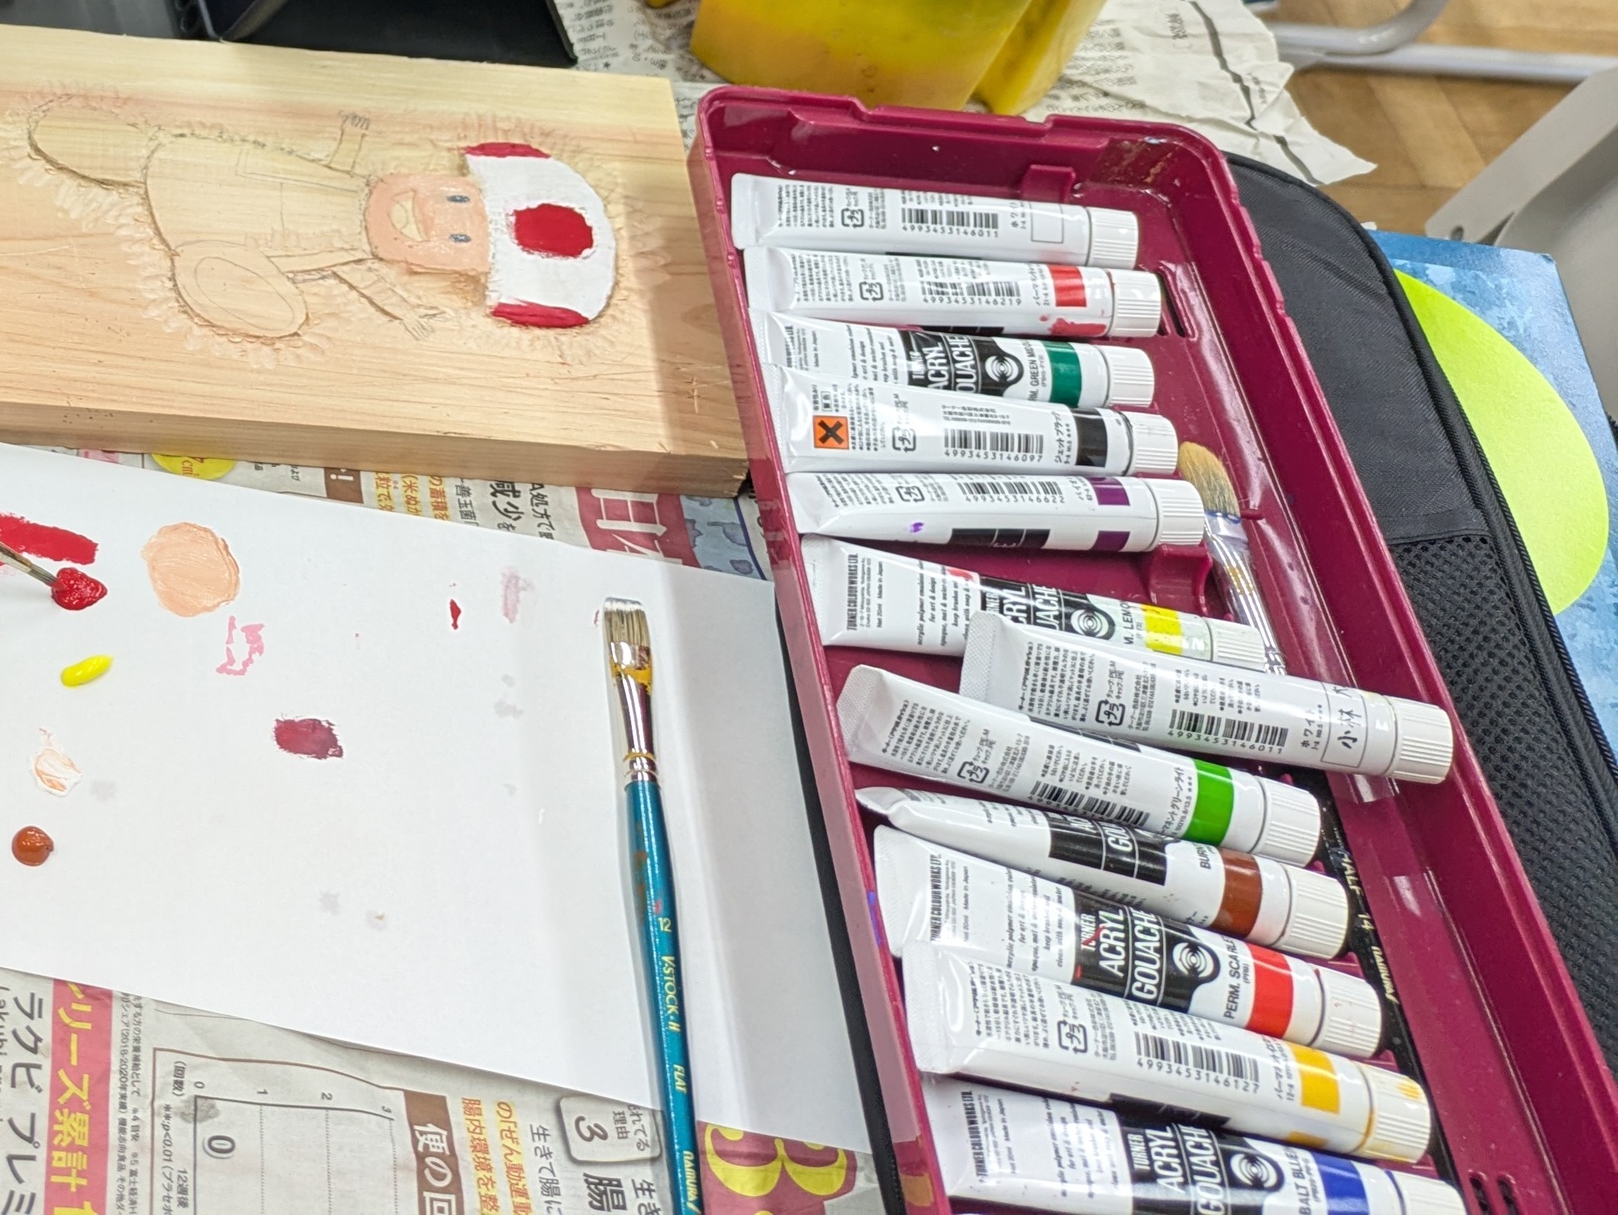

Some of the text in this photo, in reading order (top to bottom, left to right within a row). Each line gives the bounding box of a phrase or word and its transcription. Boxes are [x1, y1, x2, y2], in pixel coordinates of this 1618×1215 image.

[946, 334, 978, 394] OUACHE
[1028, 361, 1040, 388] GREEN
[944, 450, 1043, 463] 4993453146097
[848, 564, 858, 585] WORKS
[847, 586, 858, 607] COLOUR
[1003, 586, 1028, 624] CRYL
[1032, 584, 1060, 631] UACHE
[847, 607, 858, 631] TURNER
[1120, 601, 1134, 630] LEMO
[1167, 730, 1283, 755] 4993453146011
[1194, 842, 1212, 870] BURN
[930, 866, 942, 889] WORKS
[930, 890, 942, 916] COLOUR
[657, 917, 672, 933] 12
[1006, 915, 1015, 942] polymer
[1357, 912, 1375, 931] 14
[1098, 909, 1126, 978] ACRYL
[1129, 907, 1162, 1000] GOUACHE
[1223, 935, 1241, 1019] PERM. SCARLE
[10, 991, 44, 1094] ラクビ
[172, 1060, 187, 1097] (回数)
[672, 1064, 687, 1095] FLAT
[1136, 1057, 1260, 1095] 4993453146127
[612, 1110, 630, 1140] 理由
[964, 1102, 979, 1125] WORKS
[573, 1115, 609, 1143] 3
[969, 1126, 983, 1151] COLOUR
[972, 1151, 988, 1177] TURNER
[1127, 1133, 1150, 1171] TURNER
[1145, 1125, 1186, 1194] ACRYL
[412, 1123, 458, 1215] 便の回
[176, 1168, 190, 1209] 12週後
[1295, 1184, 1312, 1215] BALT
